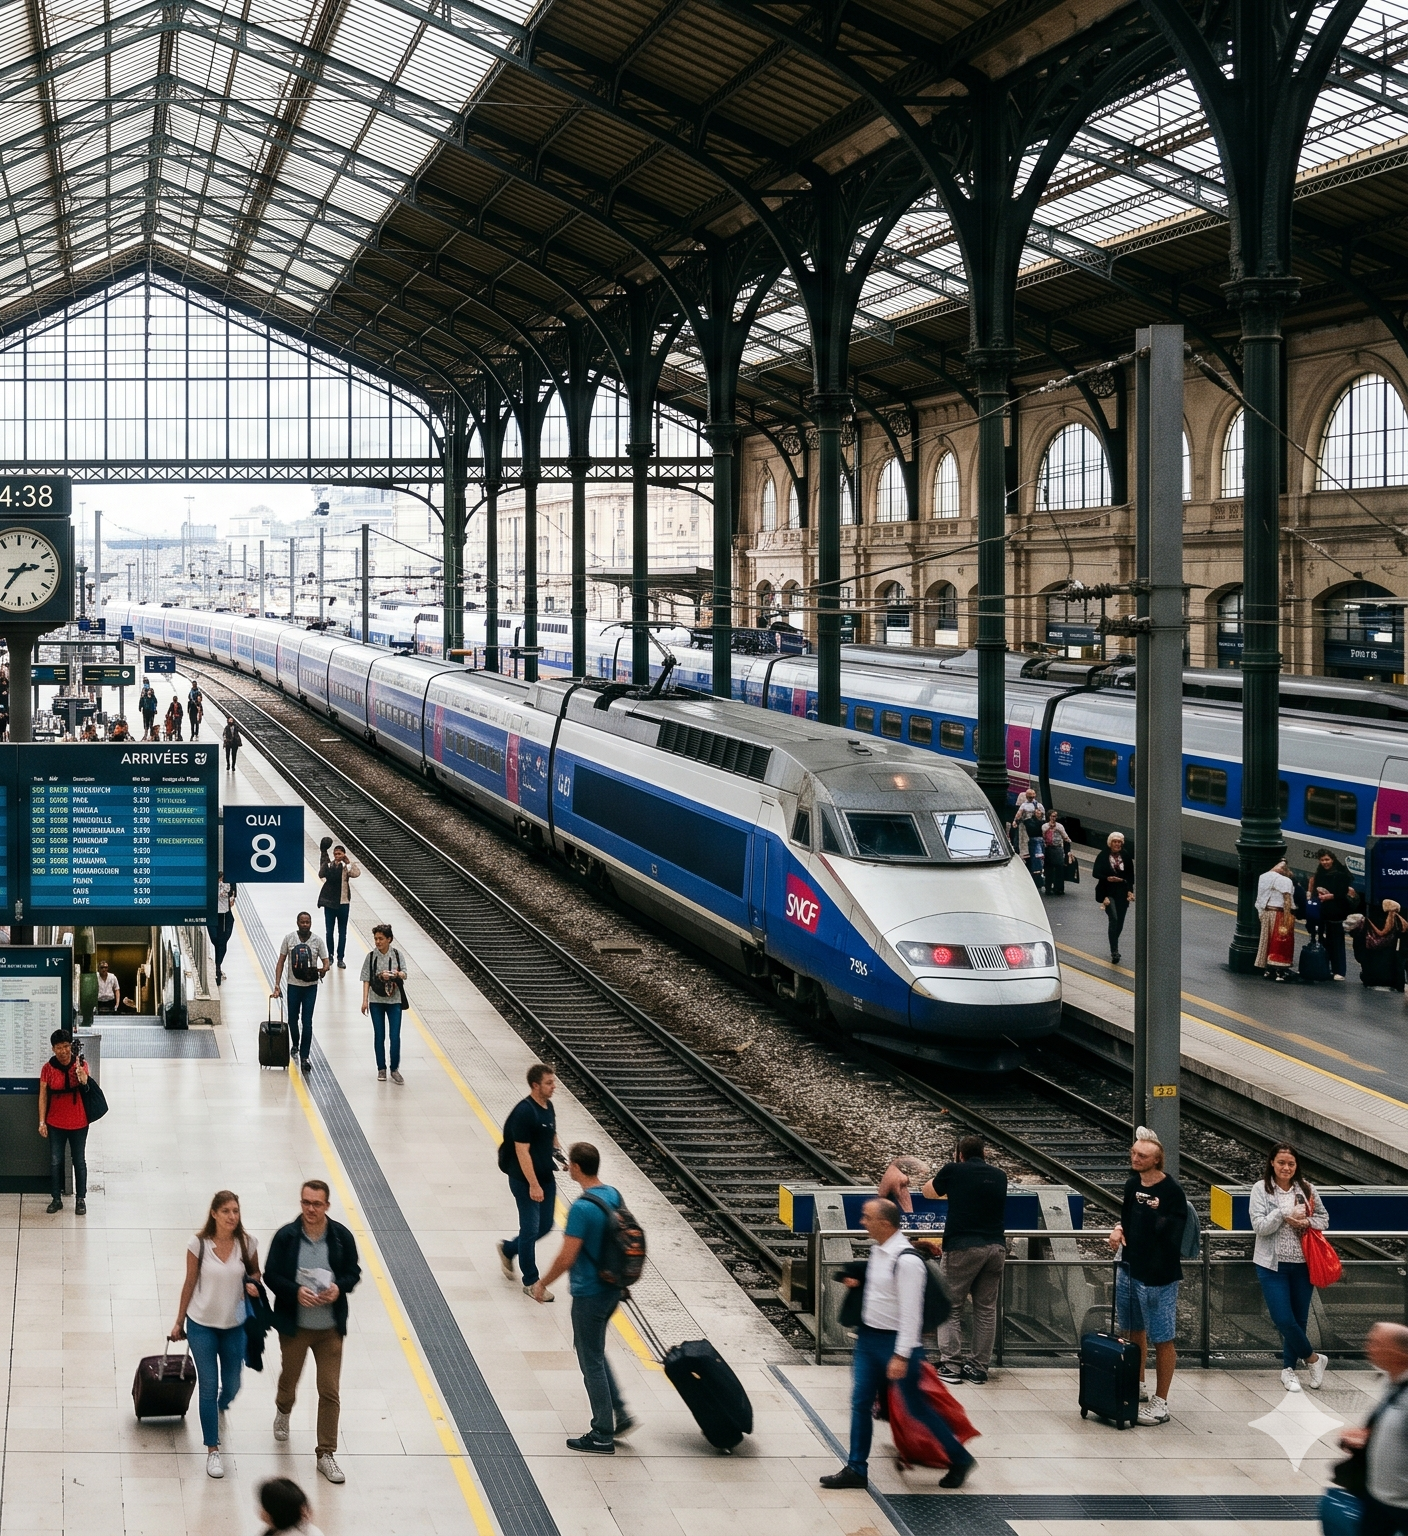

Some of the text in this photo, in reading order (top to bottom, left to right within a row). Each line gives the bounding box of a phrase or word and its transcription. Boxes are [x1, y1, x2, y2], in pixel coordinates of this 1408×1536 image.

[121, 749, 189, 764] ARRIVÉES
[245, 814, 281, 826] QUAI
[250, 833, 277, 873] 8
[786, 893, 819, 926] SNCF
